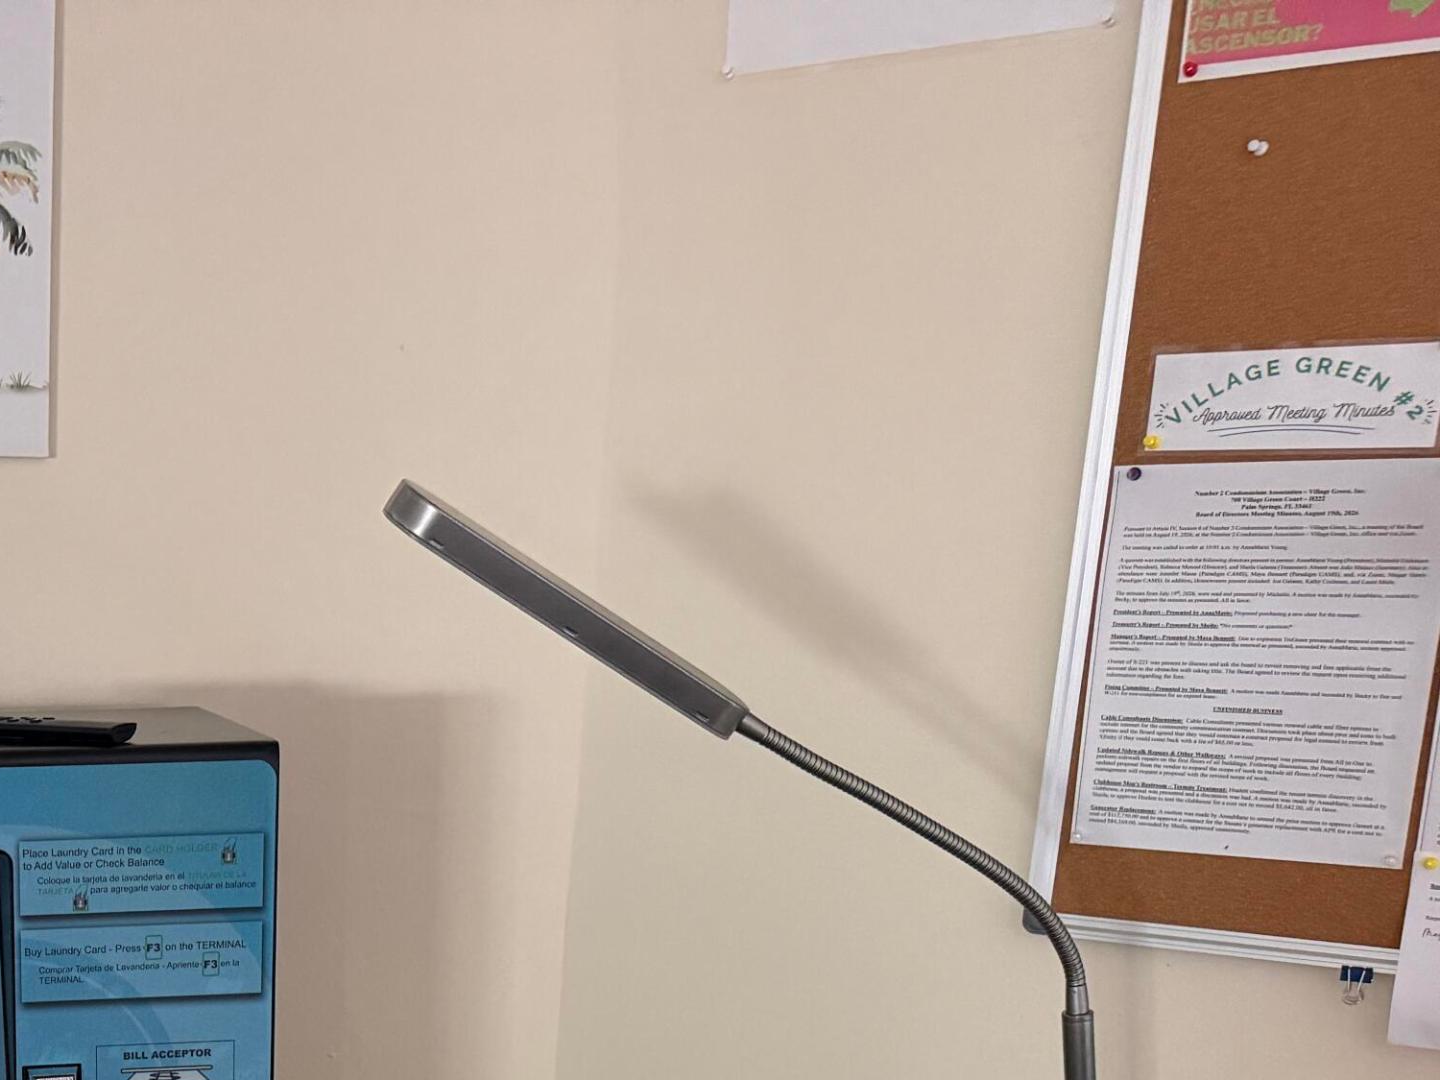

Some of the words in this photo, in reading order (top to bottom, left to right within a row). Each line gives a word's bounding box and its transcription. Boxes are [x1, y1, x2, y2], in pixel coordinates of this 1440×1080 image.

[1253, 8, 1280, 24] EL
[1187, 23, 1323, 55] ASCENSOR?
[1165, 360, 1280, 424] VILLAGE
[1296, 357, 1391, 392] GREEN
[1394, 391, 1424, 420] #2
[1192, 407, 1261, 425] Approved
[1267, 405, 1327, 423] Meeting
[1333, 402, 1395, 419] Minutes
[23, 848, 48, 858] Place
[51, 847, 88, 858] Laundry
[91, 847, 114, 856] Card
[116, 846, 125, 855] in
[127, 846, 142, 855] the
[23, 861, 32, 871] to
[34, 860, 53, 870] Add
[57, 859, 81, 869] Value
[83, 861, 94, 869] or
[95, 858, 125, 869] Check
[128, 857, 165, 868] Balance
[37, 876, 71, 886] Coloque
[72, 875, 81, 883] la
[82, 874, 107, 884] tarjeta
[109, 873, 120, 882] de
[165, 873, 176, 881] en
[177, 871, 185, 880] el
[90, 886, 108, 895] para
[111, 885, 149, 894] agregarle
[150, 883, 170, 892] valor
[180, 882, 213, 891] chequiar
[215, 881, 223, 889] el
[225, 880, 256, 889] balance
[24, 947, 42, 958] Buy
[45, 946, 82, 957] Laundry
[84, 945, 107, 954] Card
[115, 944, 141, 953] Press
[146, 943, 161, 953] F3
[165, 943, 177, 951] on
[179, 942, 194, 951] the
[196, 940, 247, 950] TERMINAL
[38, 966, 73, 976] Comprar
[75, 964, 103, 974] Tarjeta
[104, 963, 114, 972] de
[204, 959, 218, 969] F3
[220, 960, 231, 968] en
[232, 959, 240, 967] la
[123, 1051, 149, 1061] BILL
[151, 1048, 212, 1059] ACCEPTOR
